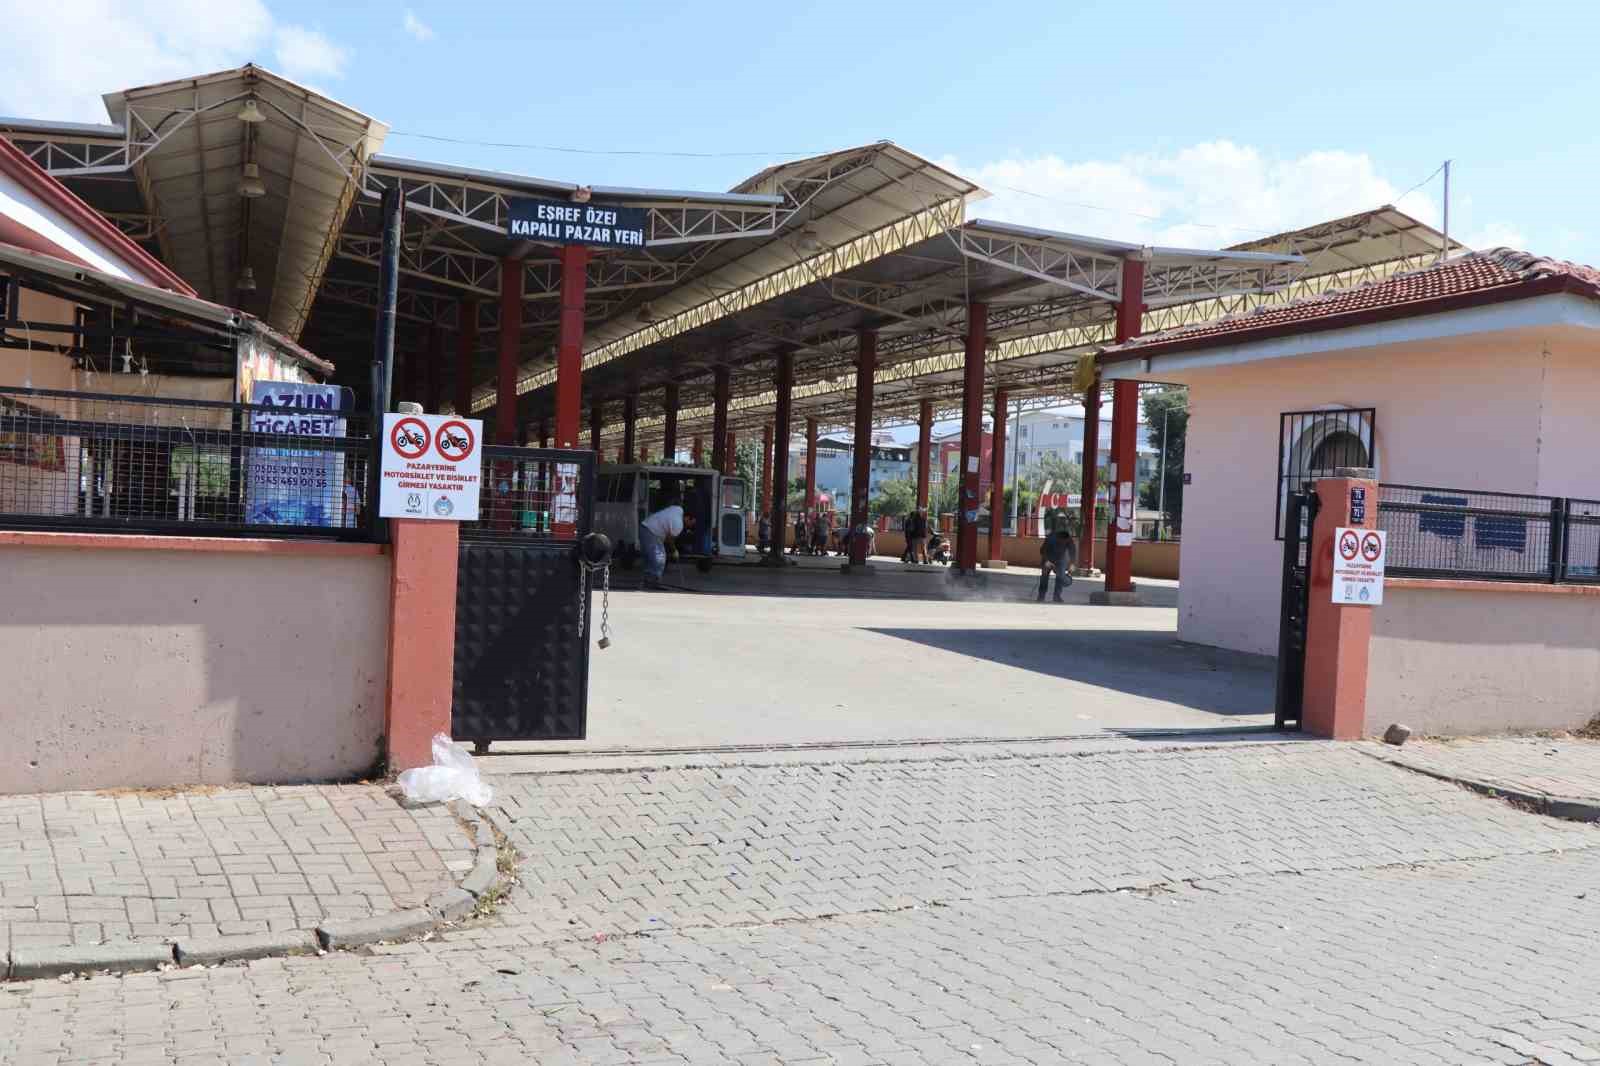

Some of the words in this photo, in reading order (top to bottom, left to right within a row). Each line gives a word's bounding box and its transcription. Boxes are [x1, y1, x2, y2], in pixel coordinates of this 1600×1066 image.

[537, 205, 581, 222] EŞREF
[511, 220, 560, 238] KAPALI
[565, 225, 611, 243] PAZAR
[614, 228, 643, 246] YERİ
